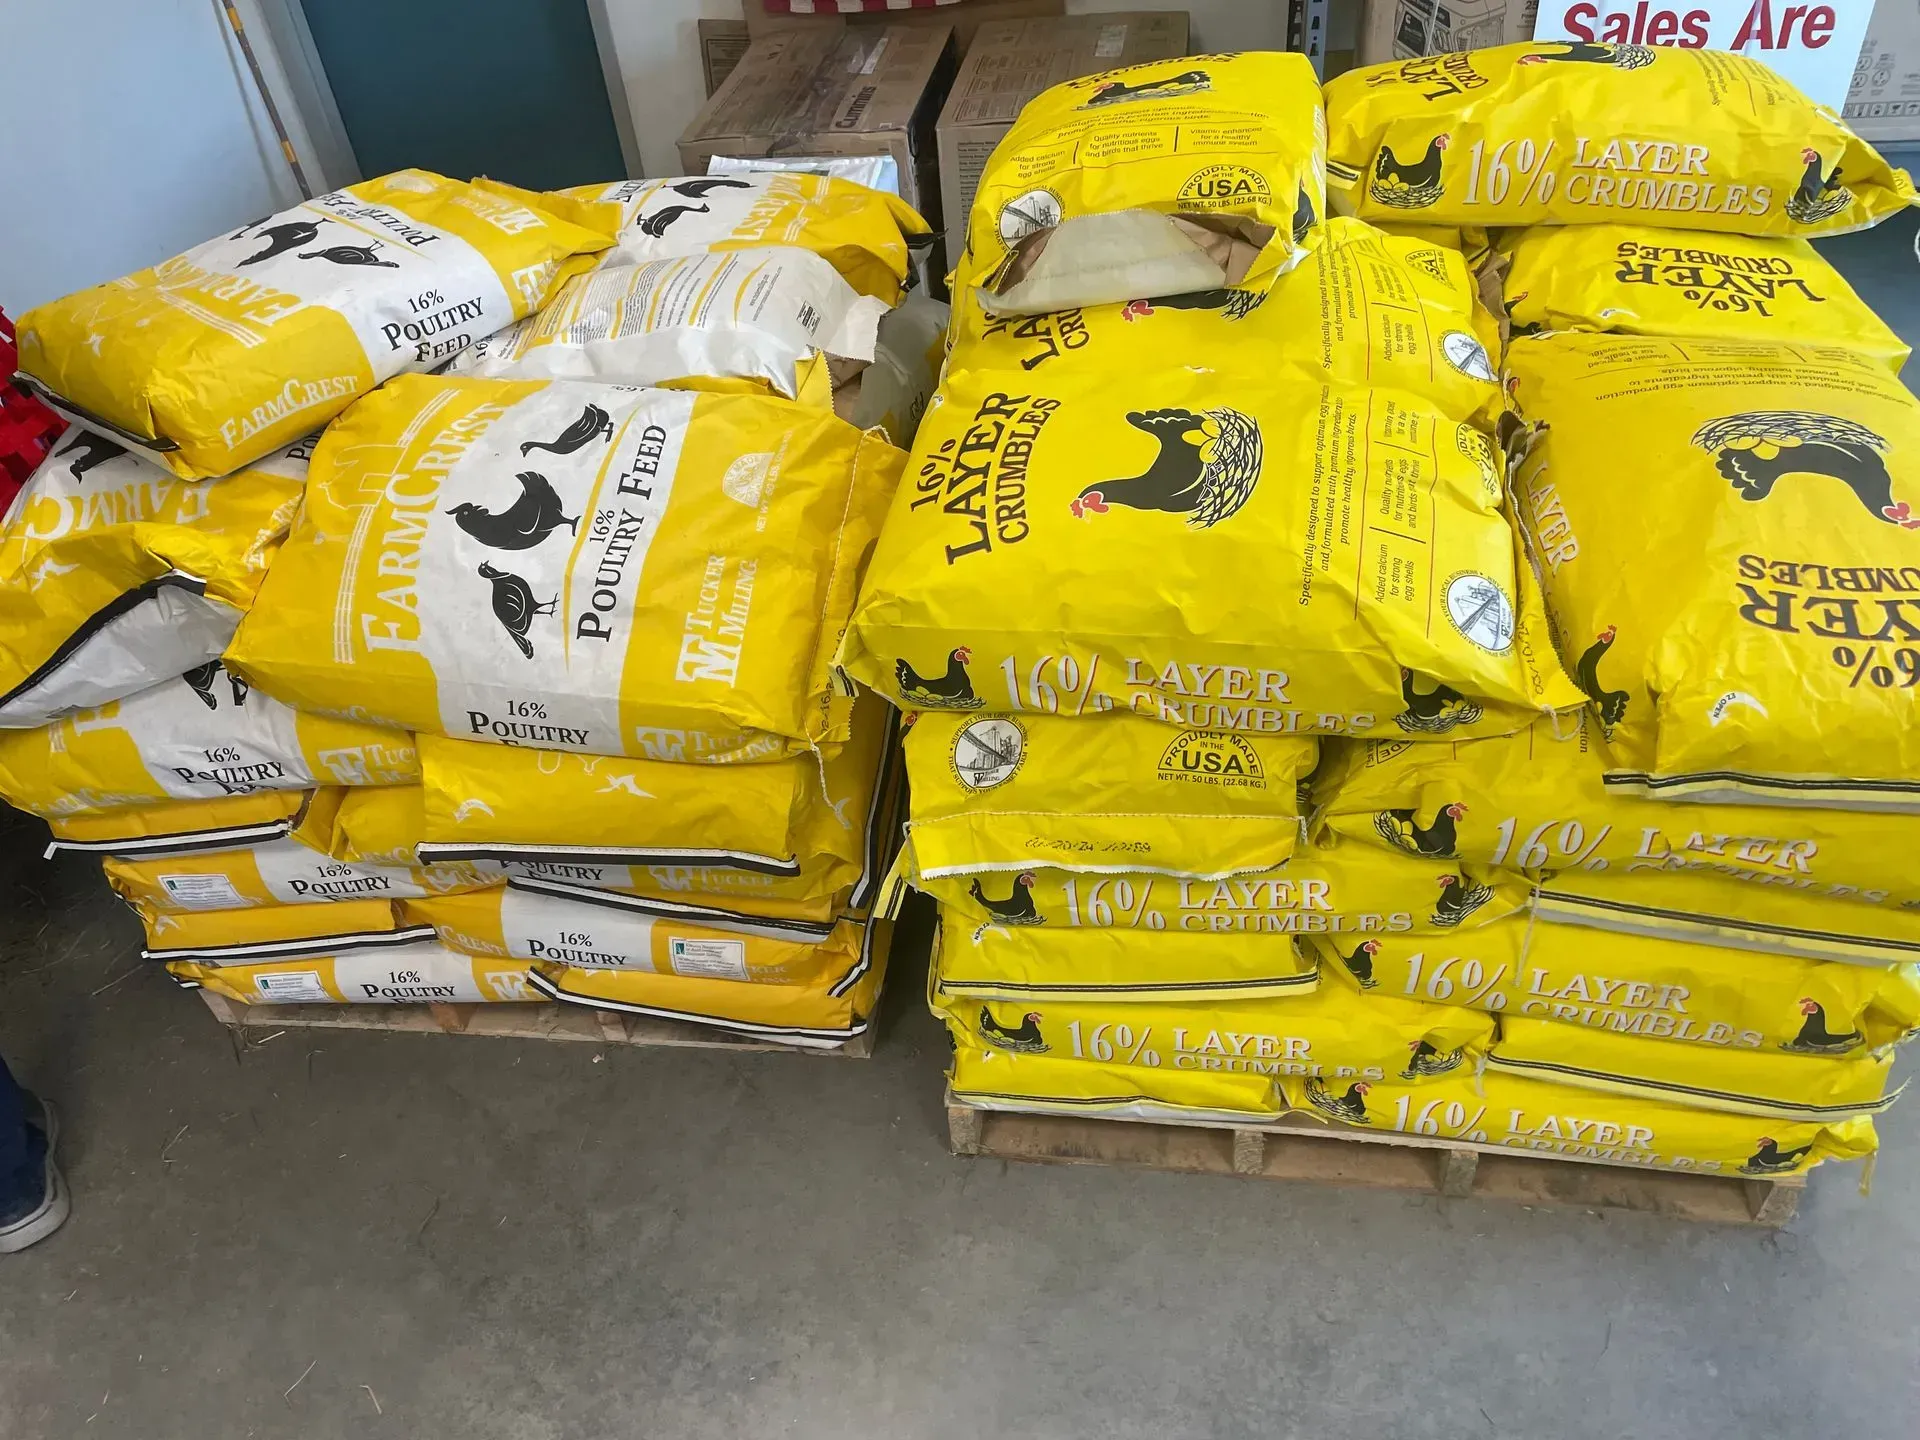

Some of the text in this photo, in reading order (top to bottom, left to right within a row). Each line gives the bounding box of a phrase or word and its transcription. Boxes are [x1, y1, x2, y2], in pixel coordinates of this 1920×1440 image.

[1563, 0, 1836, 50] Sales Are
[834, 84, 878, 130] Cummins
[1089, 143, 1101, 151] for
[1102, 138, 1138, 149] nutritious
[1094, 130, 1158, 143] Quality nutrients
[1190, 126, 1263, 136] Vitamin enhanced
[1200, 132, 1251, 142] for healthy
[1009, 149, 1066, 164] Added calcium
[1019, 158, 1056, 171] for strong
[1085, 142, 1164, 159] and birds that thrive
[1017, 170, 1035, 180] egg
[1182, 164, 1268, 198] PROUDLY MADE
[1462, 136, 1711, 208] 16% LAYER
[1177, 195, 1273, 210] NET WT. 50 LBS. (22.68 KG.)
[1196, 178, 1253, 199] USA
[1564, 174, 1773, 217] CRUMBLES
[1616, 242, 1794, 276] CRUMBLES
[1614, 259, 1826, 303] LAYER
[408, 288, 444, 315] 16%
[1330, 270, 1346, 342] and formulated with
[1345, 289, 1358, 320] promote
[1682, 289, 1774, 318] 16%
[381, 296, 485, 351] POULTRY
[1318, 278, 1333, 369] Specifically designed to
[1380, 313, 1393, 362] Added calcium
[1393, 322, 1405, 353] for strong
[1405, 323, 1417, 355] egg shells
[415, 331, 472, 363] FEED
[1643, 372, 1711, 385] ingredients
[1658, 366, 1691, 375] birds.
[1662, 381, 1685, 392] egg
[1688, 380, 1740, 389] optimum
[1712, 370, 1764, 381] premium
[1742, 378, 1787, 388] support
[1595, 384, 1660, 402] production
[219, 375, 359, 452] FARMCREST
[910, 438, 957, 513] 16%
[943, 391, 1032, 566] LAYER
[995, 397, 1062, 544] CRUMBLES
[1311, 453, 1326, 485] support
[1339, 412, 1357, 546] promote healthy, birds.
[1310, 485, 1321, 496] to
[1320, 439, 1342, 572] and formulated with premium
[1379, 486, 1394, 516] Quality
[360, 400, 508, 653] FARMCREST
[1305, 497, 1322, 541] designed
[1393, 510, 1404, 522] for
[1407, 492, 1418, 529] and birds
[1524, 458, 1581, 578] LAYER
[575, 424, 668, 644] POULTRY FEED
[588, 509, 616, 545] 16%
[1298, 542, 1317, 607] Specifically
[1375, 544, 1389, 604] Added calcium
[1389, 557, 1403, 597] for strong
[1404, 560, 1416, 602] egg shells
[685, 554, 728, 630] TUCKER
[717, 558, 760, 640] MILLING
[1735, 582, 1920, 644] YER
[999, 651, 1292, 714] 16% LAYER
[506, 699, 548, 721] 16%
[1127, 690, 1377, 737] CRUMBLES
[1712, 692, 1737, 719] EZ OPEN
[466, 710, 591, 747] POULTRY
[950, 712, 993, 746] SUPPORT YOUR
[203, 746, 241, 764] 16%
[1164, 731, 1260, 776] PROUDLY MADE
[1181, 750, 1245, 775] USA
[1199, 741, 1226, 752] IN THE
[172, 760, 286, 785] POULTRY
[1157, 772, 1268, 791] NET WT. 50 LBS. (22.68 KG.)
[1489, 815, 1819, 874] 16% LAYER
[288, 875, 392, 896] POULTRY
[315, 863, 352, 879] 16%
[699, 863, 774, 886] TUCKER
[1062, 877, 1336, 931] 16% LAYER
[1179, 911, 1415, 935] CRUMBLES
[526, 938, 627, 967] POULTRY
[558, 931, 593, 949] 16%
[359, 983, 457, 999] POULTRY
[390, 970, 421, 985] 16%
[1402, 950, 1693, 1014] 16% LAYER
[1520, 999, 1765, 1049] CRUMBLES
[1066, 1019, 1312, 1069] 16% LAYER
[1172, 1053, 1385, 1082] CRUMBLES
[1394, 1093, 1656, 1152] 16% LAYER
[1502, 1136, 1724, 1174] CRUMBLES
